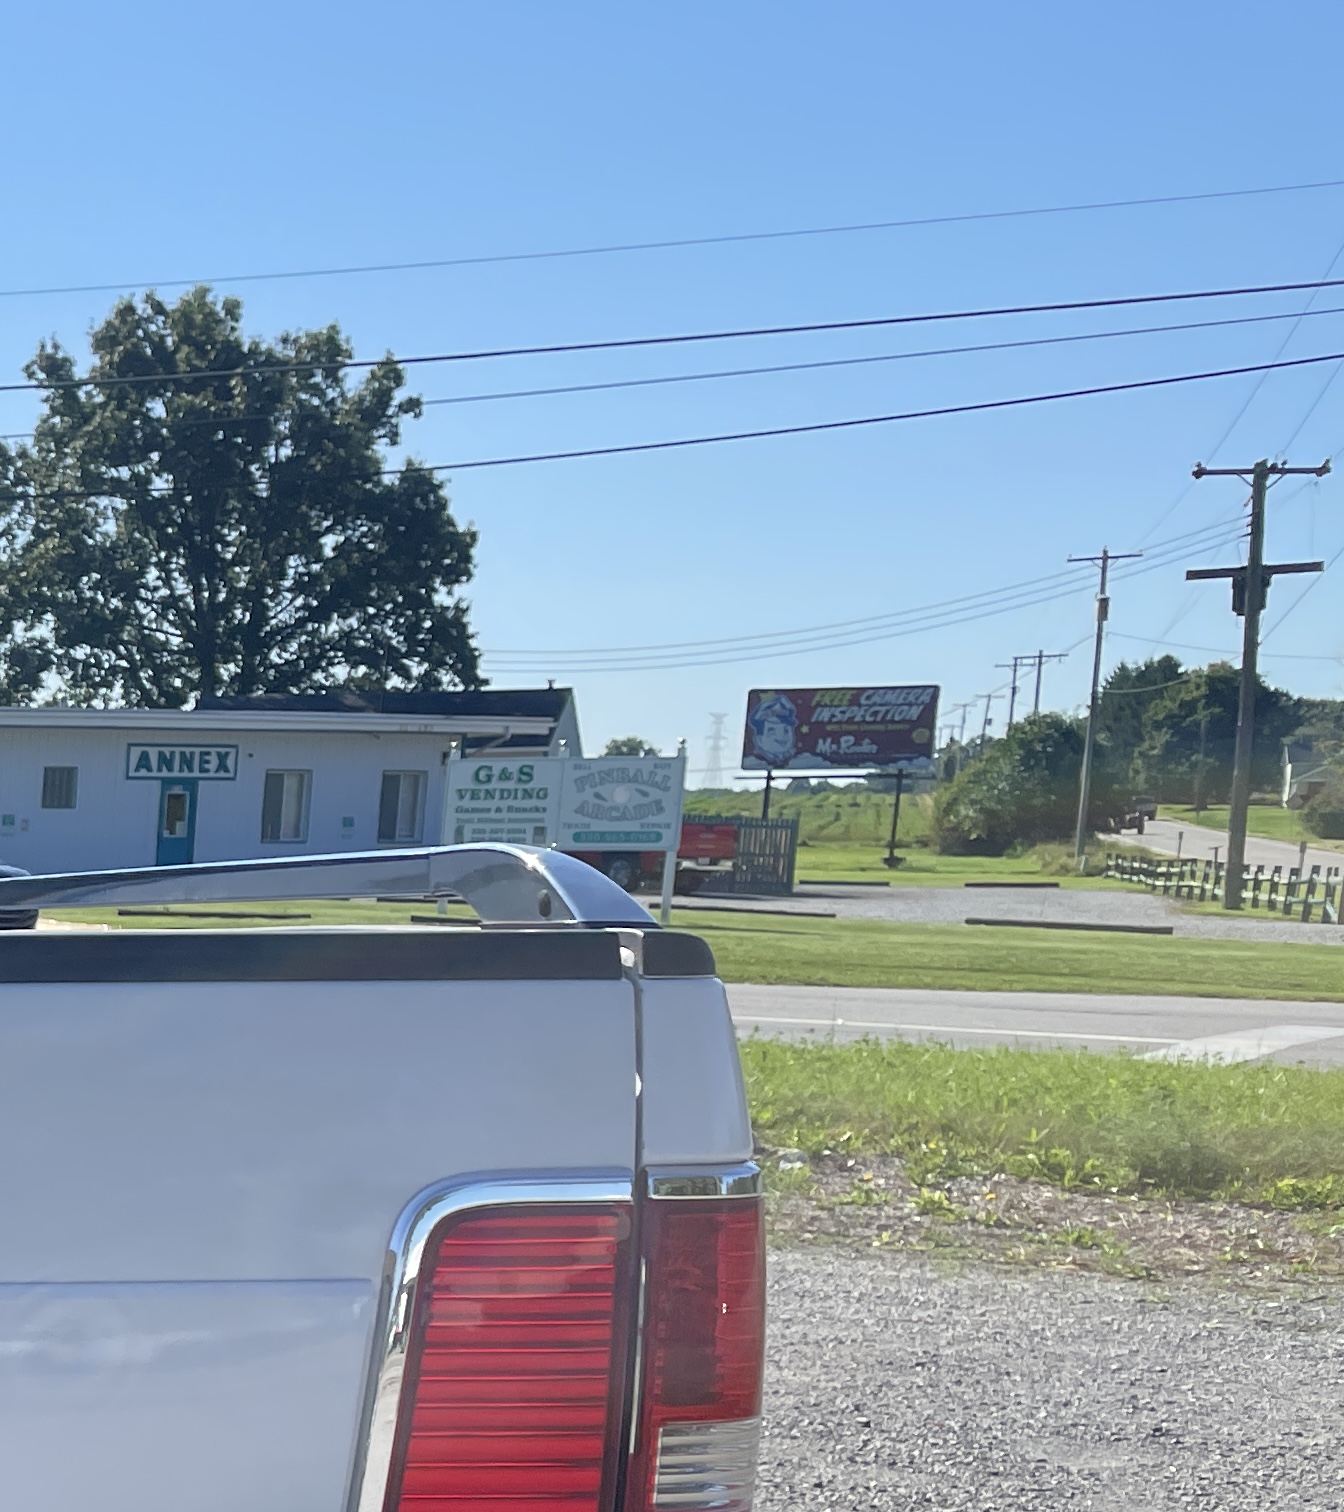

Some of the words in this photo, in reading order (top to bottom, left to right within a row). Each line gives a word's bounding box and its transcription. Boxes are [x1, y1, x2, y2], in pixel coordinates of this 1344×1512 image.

[811, 690, 857, 706] FREE
[859, 688, 934, 705] CAMERA
[811, 705, 925, 722] INSPECTION
[134, 750, 232, 773] ANNEX
[573, 767, 672, 793] PINBALL
[455, 787, 549, 800] VENDING
[573, 799, 666, 822] ARCADE
